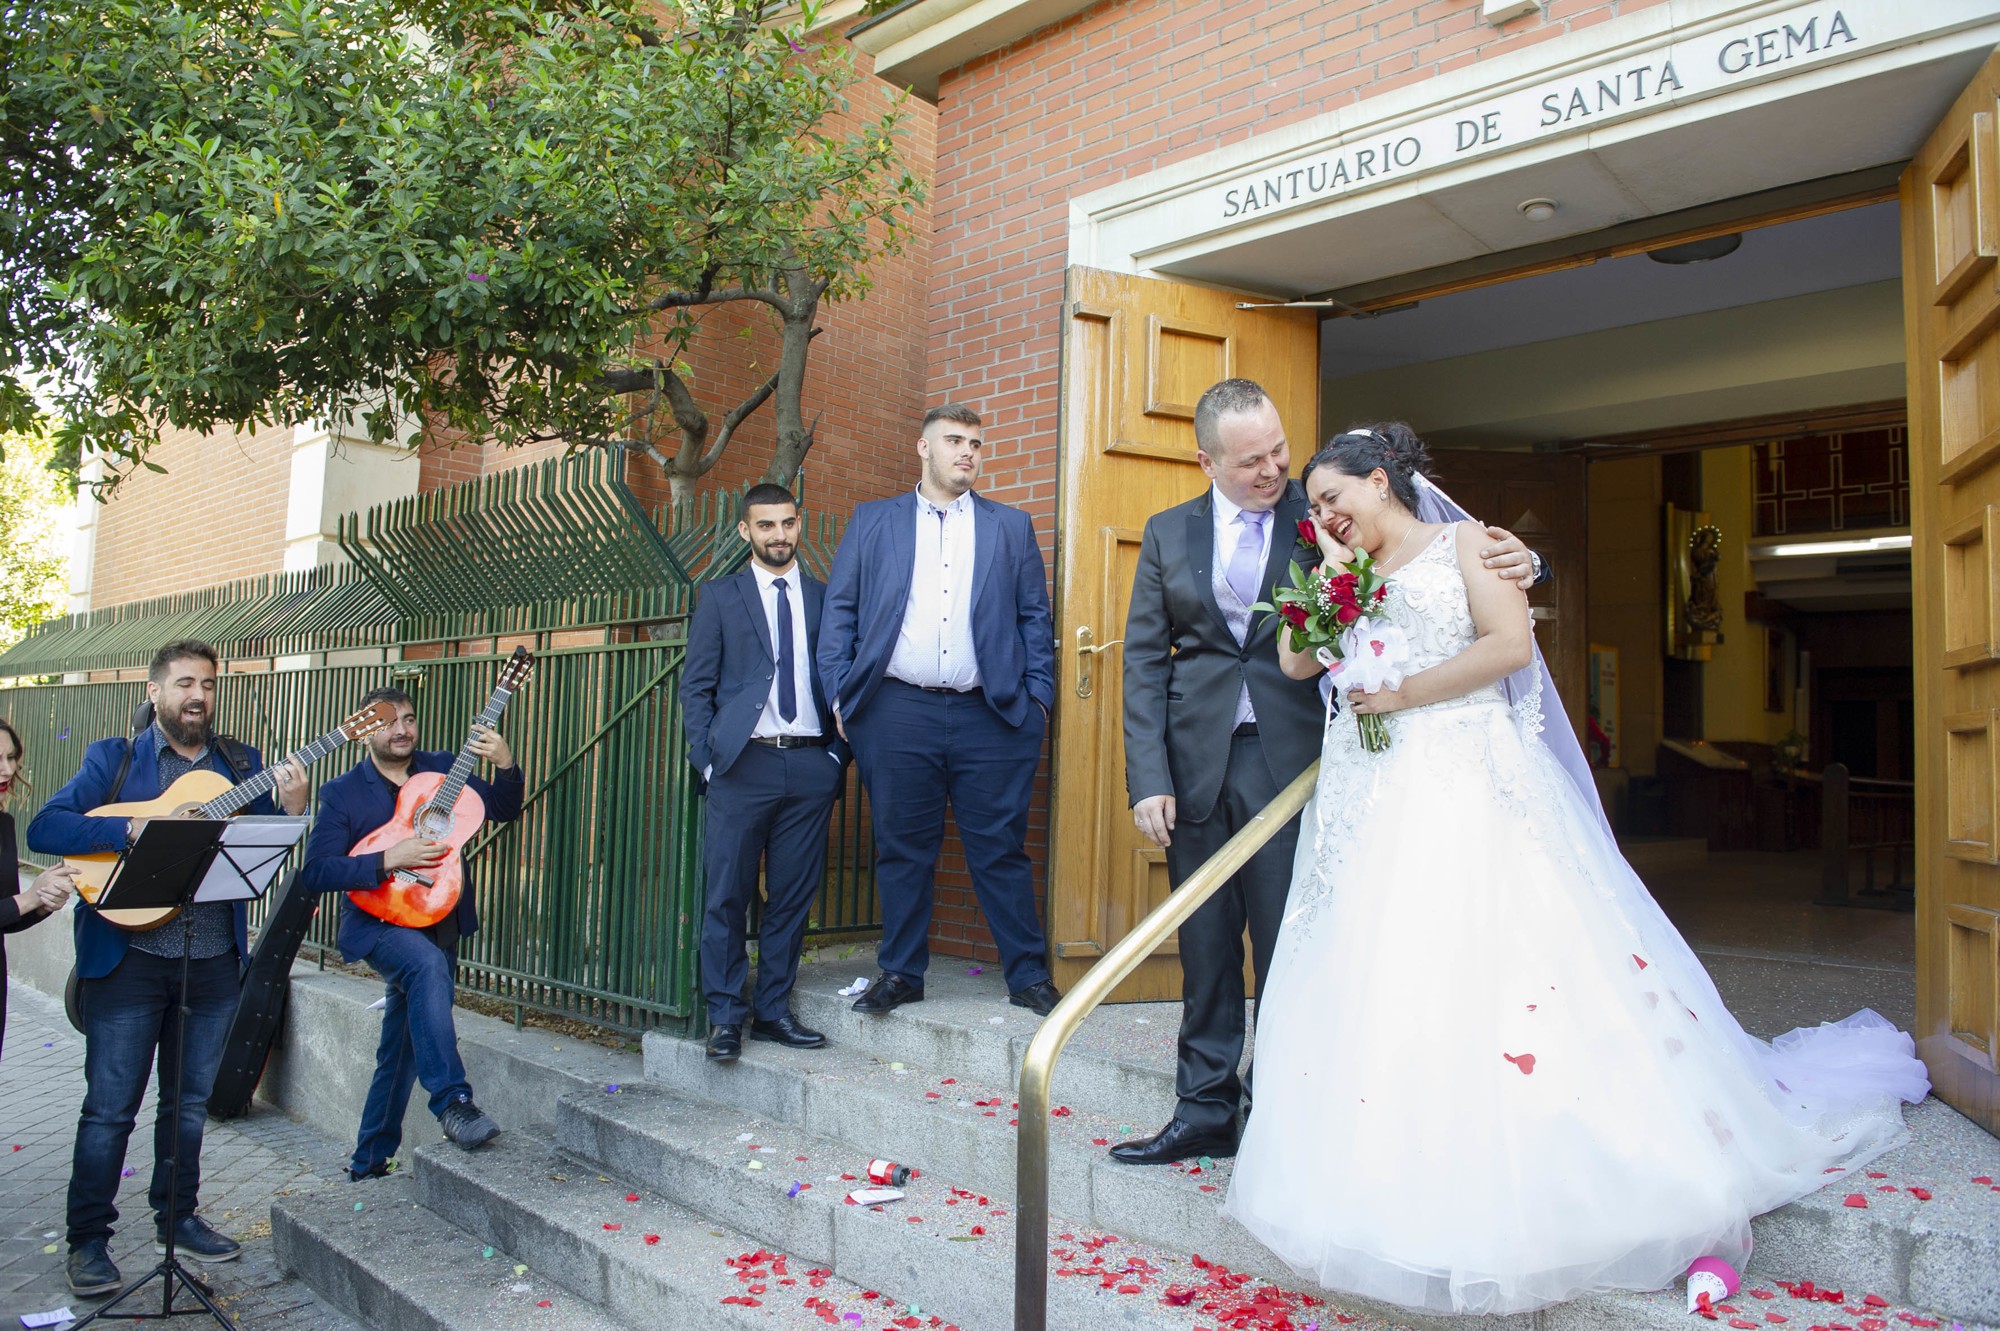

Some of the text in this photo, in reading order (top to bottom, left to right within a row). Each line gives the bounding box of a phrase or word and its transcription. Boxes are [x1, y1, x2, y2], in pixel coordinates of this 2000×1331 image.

[1224, 10, 1857, 218] SANTUARIO DE SANTA GEMA
